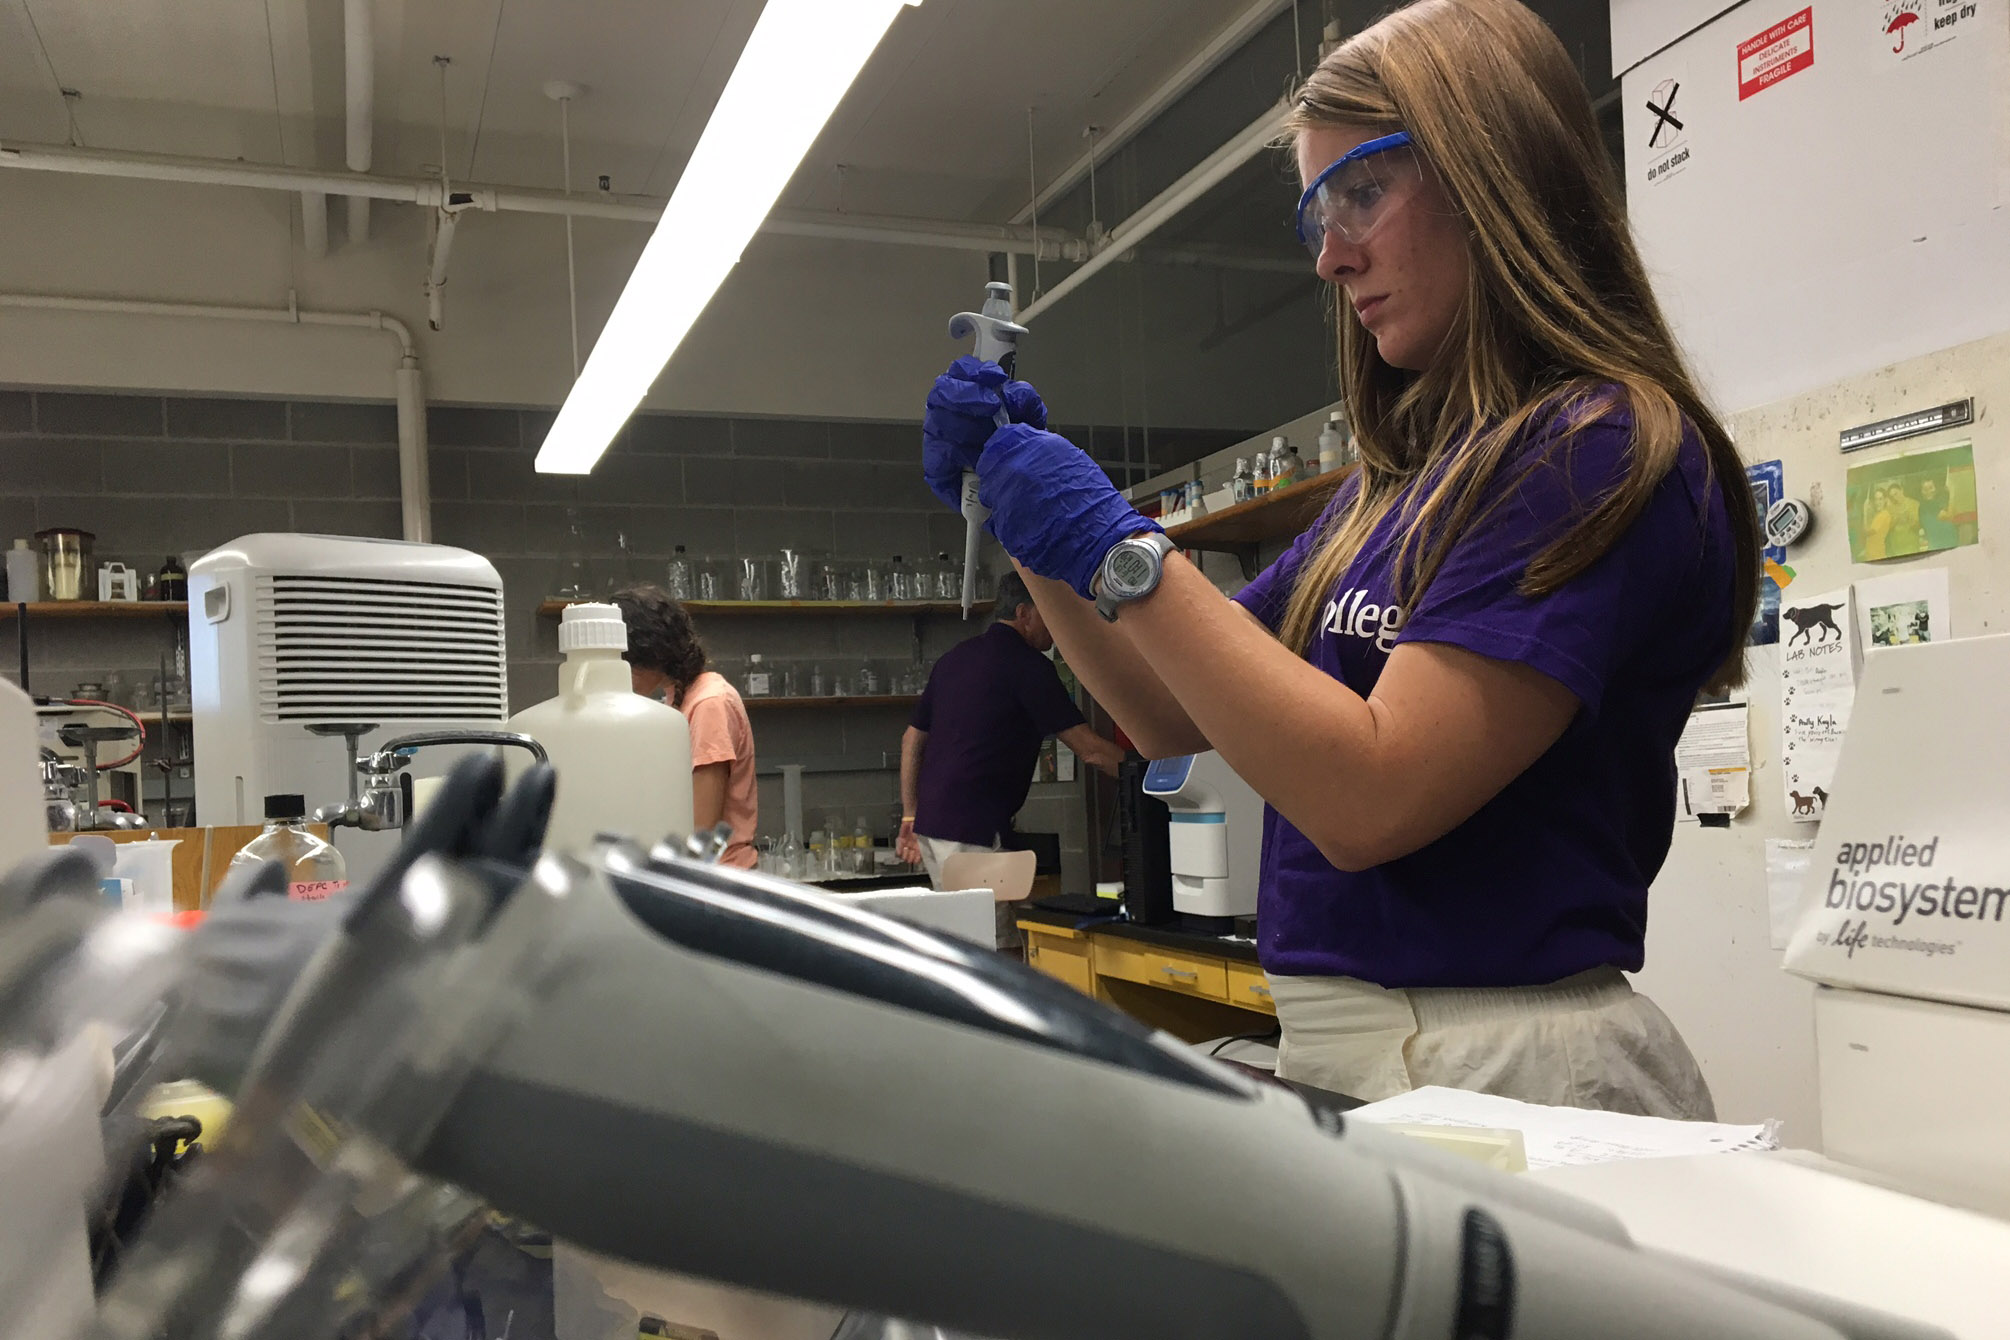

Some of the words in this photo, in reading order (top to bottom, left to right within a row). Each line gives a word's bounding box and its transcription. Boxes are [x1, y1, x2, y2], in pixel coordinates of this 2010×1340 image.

[1934, 12, 1957, 30] keep
[1960, 3, 1977, 19] dry
[1741, 34, 1768, 56] HANDLE
[1768, 25, 1786, 40] WITH
[1787, 13, 1807, 30] CARE
[1752, 46, 1798, 75] INSTRUMENTS
[1758, 38, 1791, 61] DELICATE
[1759, 62, 1792, 86] FRAGILE
[1647, 168, 1657, 181] do
[1658, 159, 1670, 175] not
[1671, 147, 1690, 168] stack
[1786, 649, 1805, 662] LAB
[1809, 641, 1843, 658] NOTES
[1836, 836, 1939, 874] applied
[296, 882, 327, 894] DEPC
[1816, 931, 1830, 945] by
[1831, 919, 1869, 959] life
